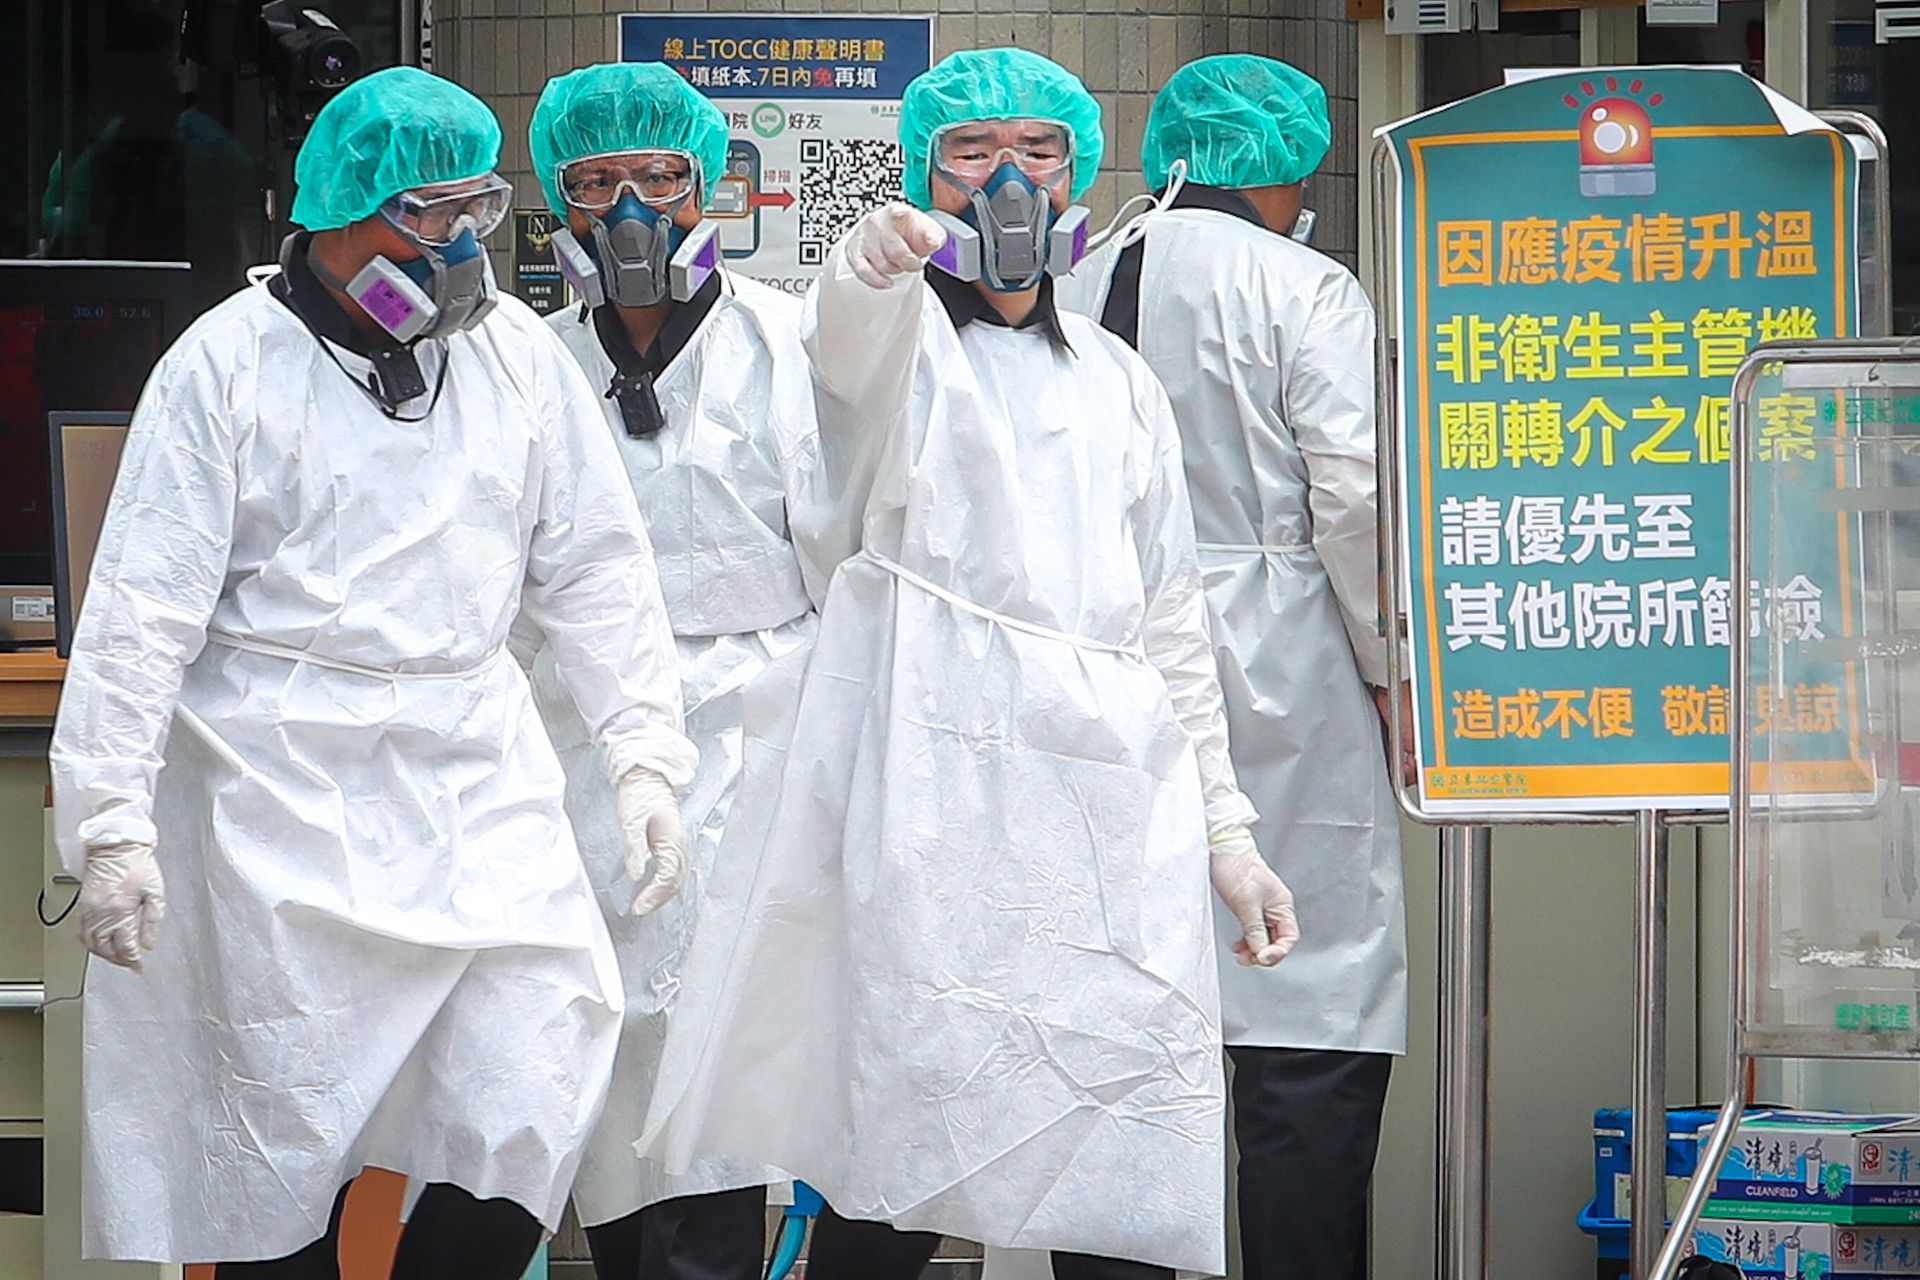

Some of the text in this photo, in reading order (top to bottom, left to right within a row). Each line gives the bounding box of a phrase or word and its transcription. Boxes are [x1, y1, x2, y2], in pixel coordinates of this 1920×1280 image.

[664, 38, 885, 61] 線上TOCC健康聲明書
[789, 113, 823, 131] 好友
[1436, 210, 1818, 287] 因應疫情升溫
[1438, 393, 1817, 469] 關轉介之個案
[1440, 493, 1697, 566] 請優先至
[1443, 574, 1825, 652] 其他院所篩檢
[1452, 686, 1634, 739] 造成不便
[1887, 1146, 1920, 1183] 清
[1745, 1185, 1798, 1199] CLEANFIELD
